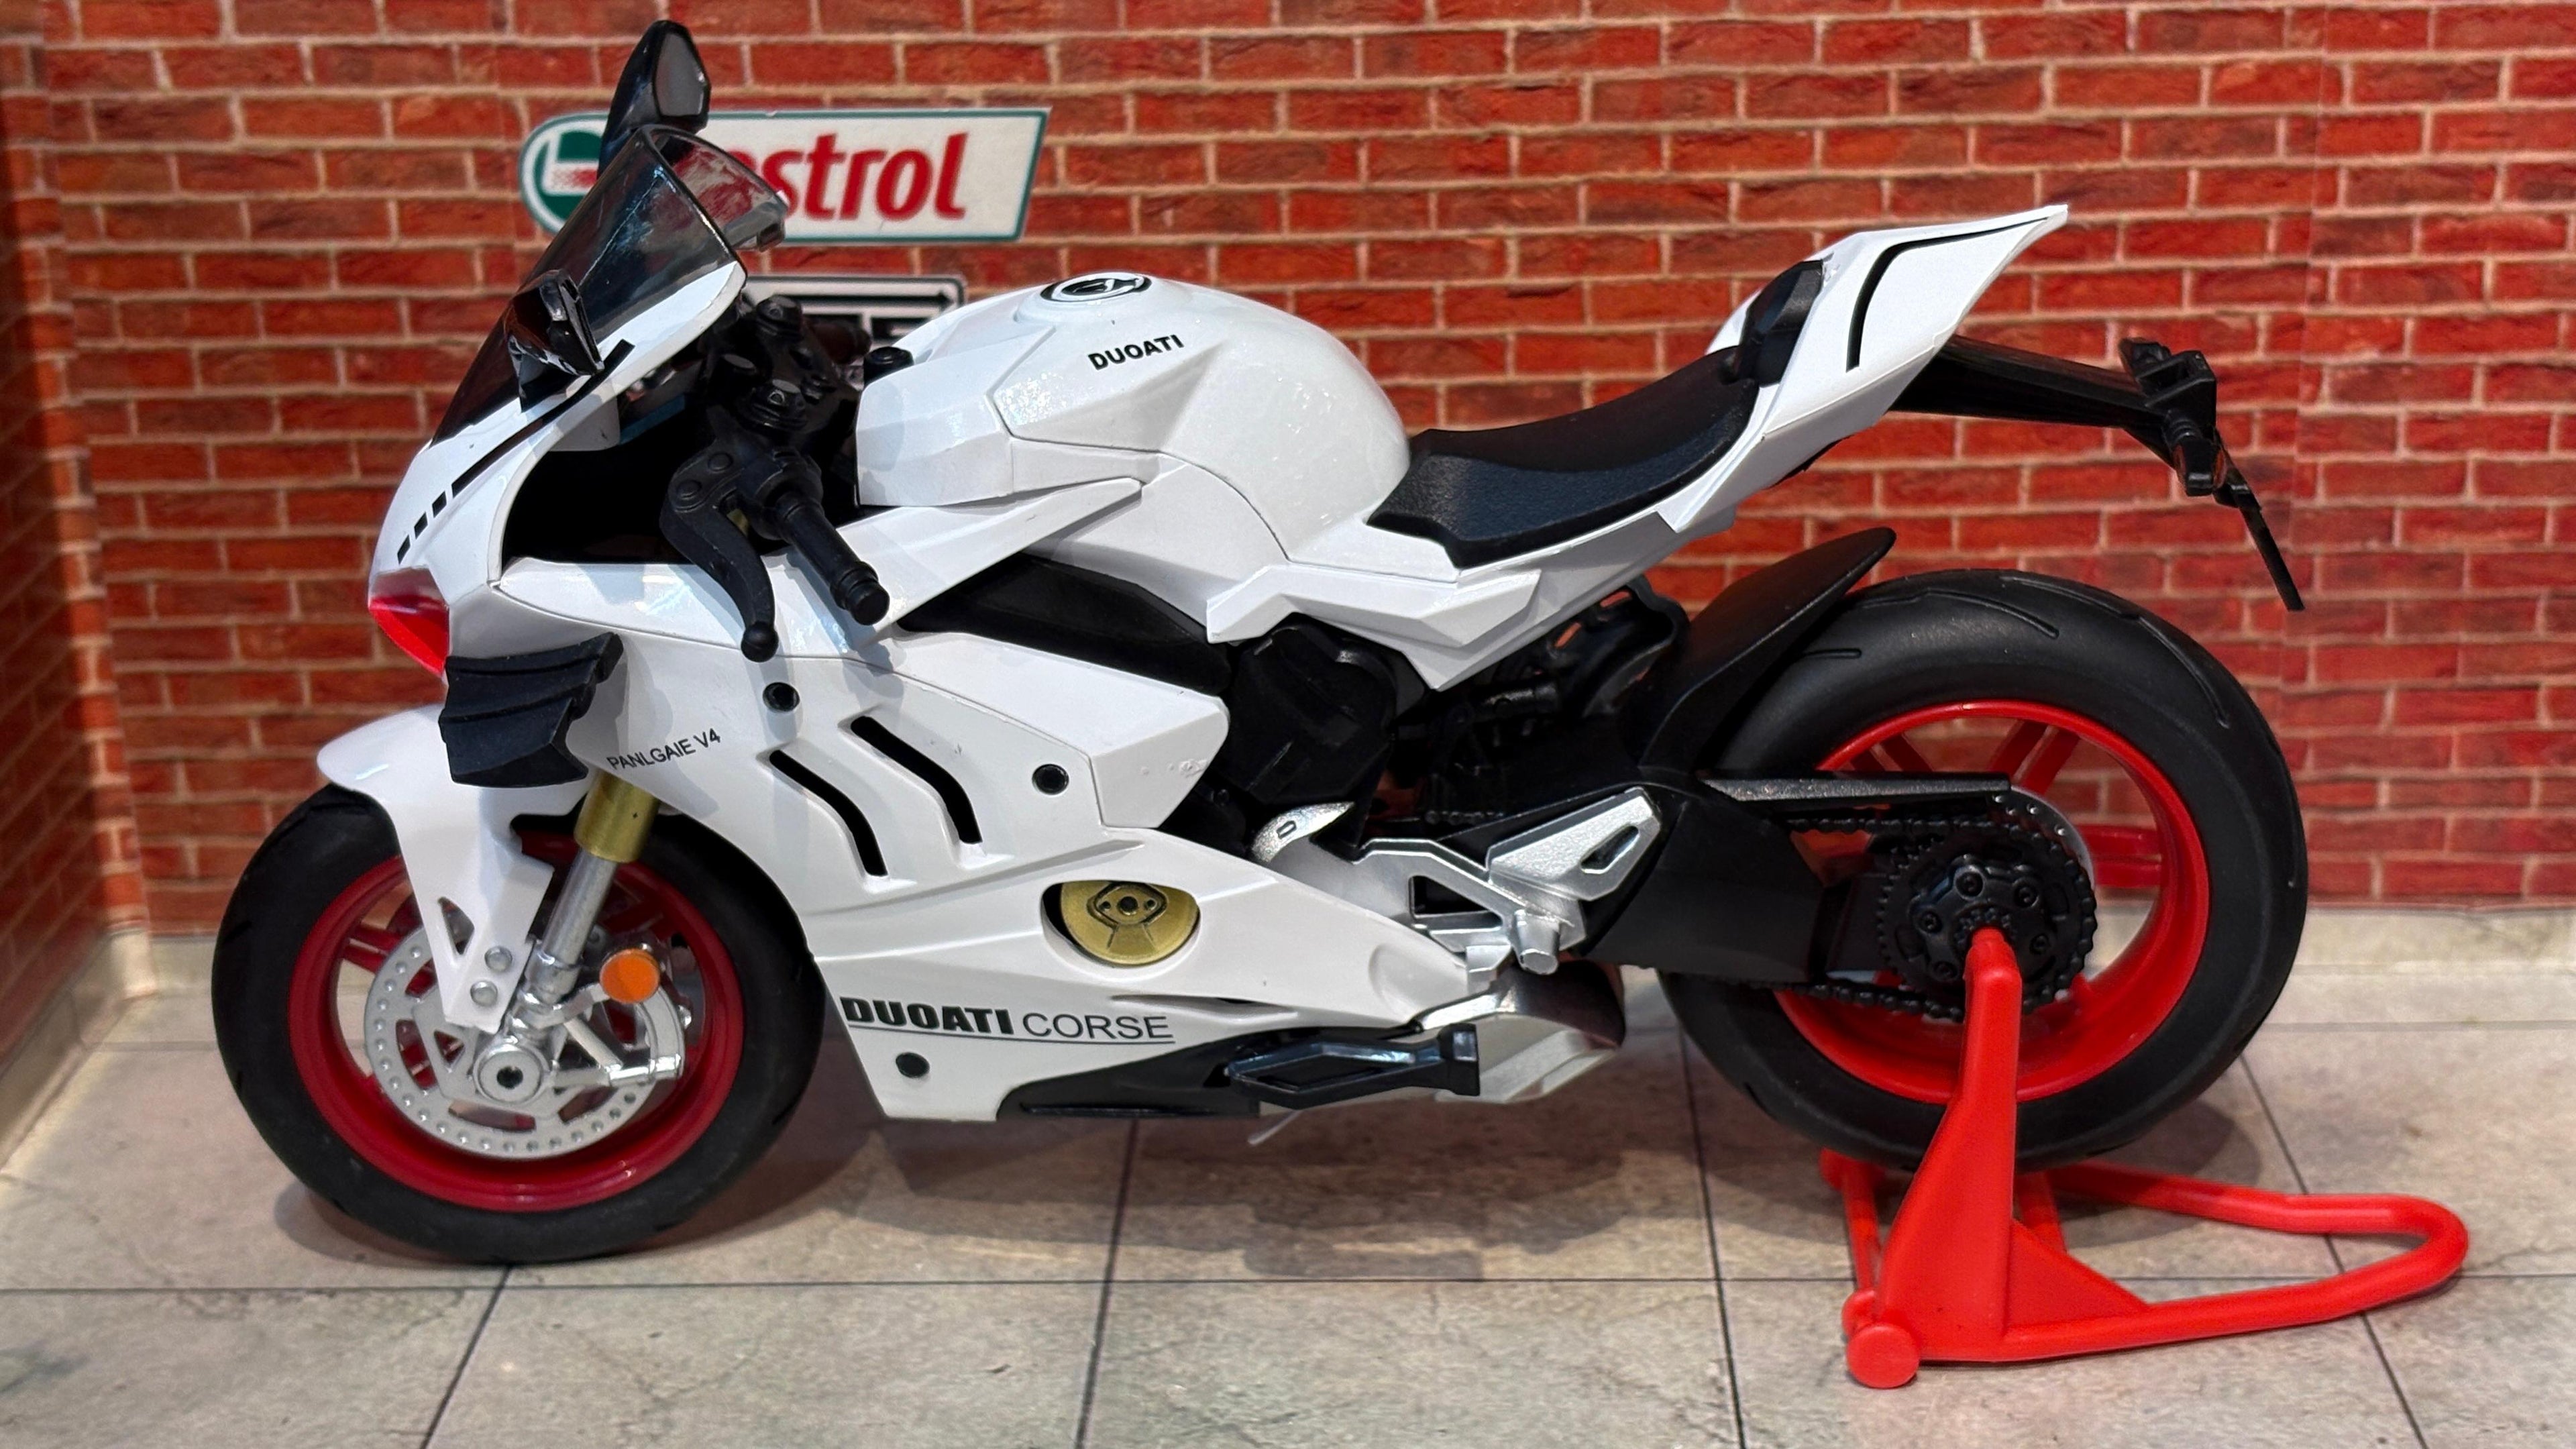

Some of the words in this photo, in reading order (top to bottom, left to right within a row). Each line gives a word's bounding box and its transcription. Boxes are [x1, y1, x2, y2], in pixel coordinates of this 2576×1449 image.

[673, 132, 970, 221] strol
[1087, 334, 1185, 370] DUOATI
[606, 739, 696, 770] PANLGAIE
[693, 728, 721, 748] V4
[840, 996, 1015, 1034] DUOATI
[1022, 1012, 1175, 1040] CORSE
